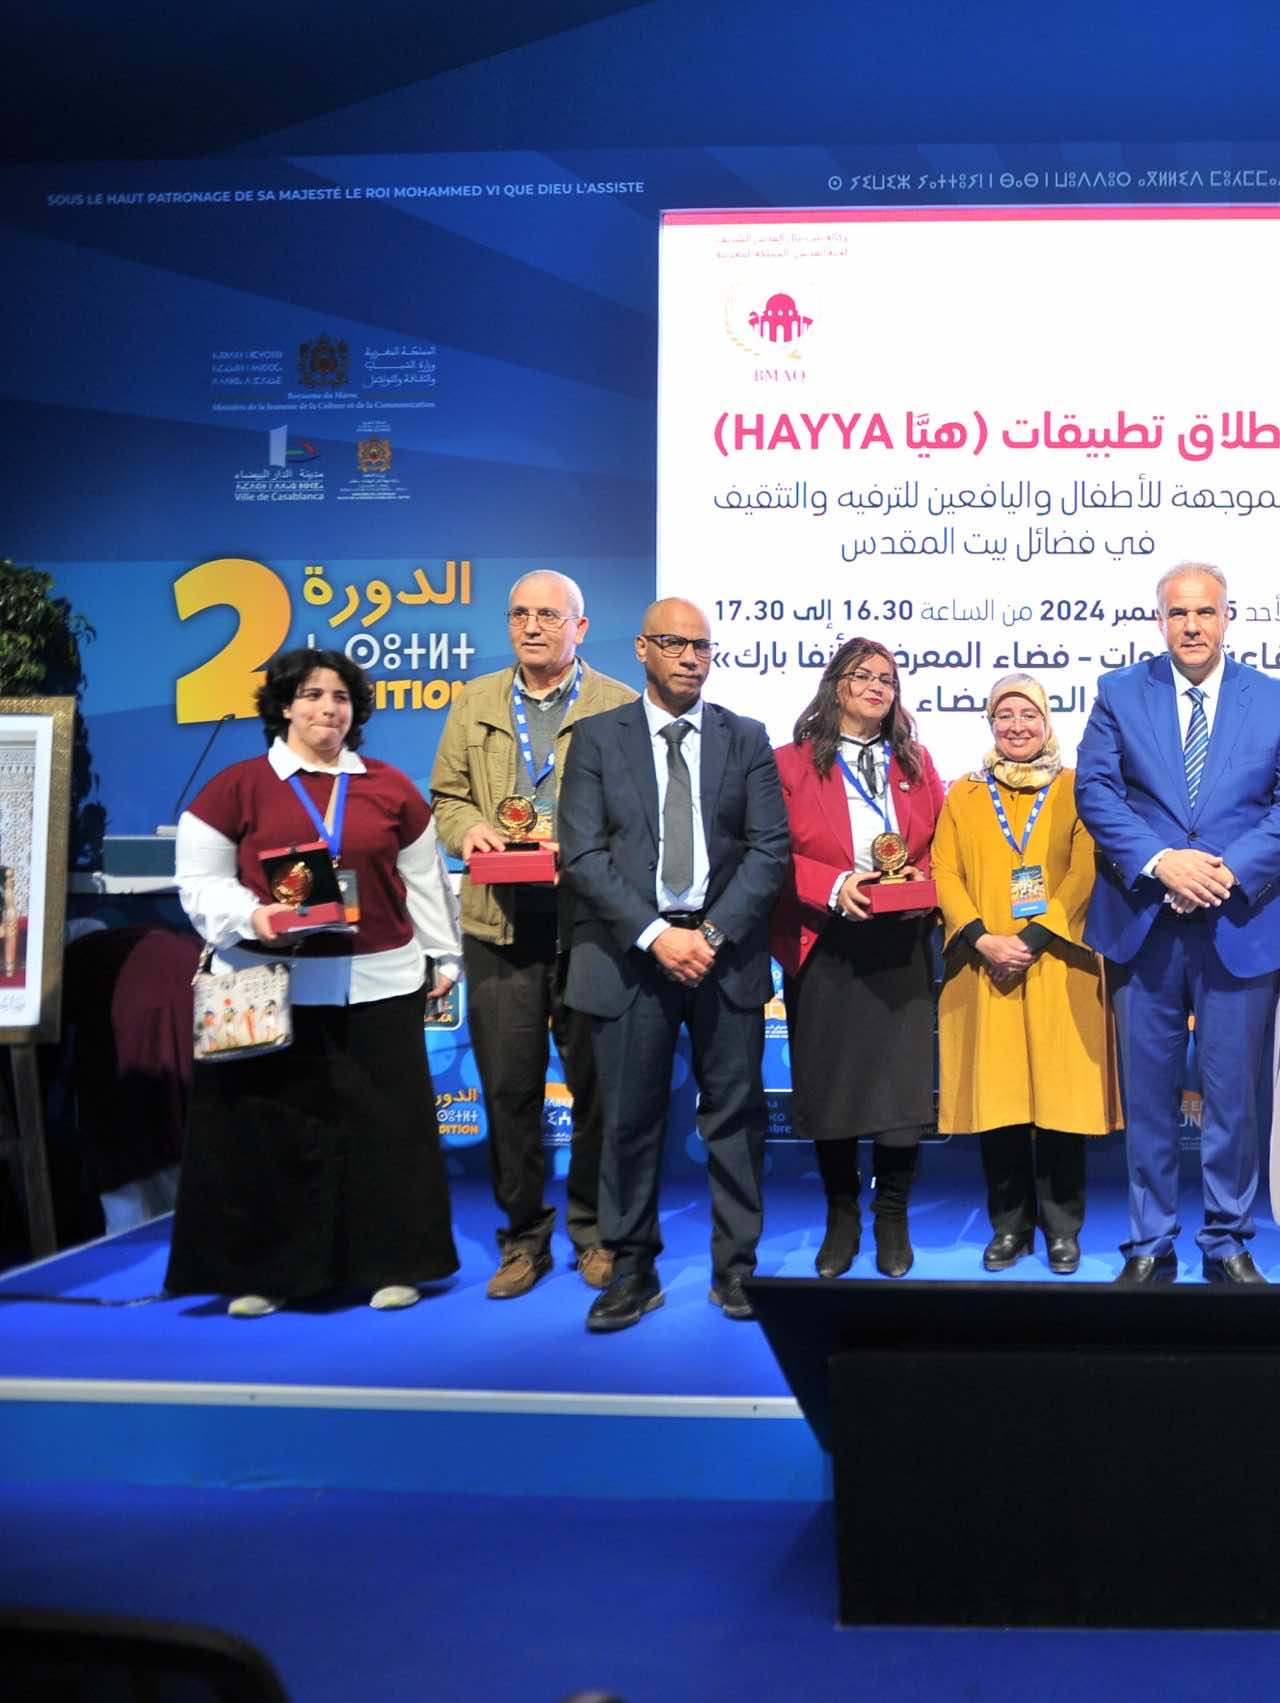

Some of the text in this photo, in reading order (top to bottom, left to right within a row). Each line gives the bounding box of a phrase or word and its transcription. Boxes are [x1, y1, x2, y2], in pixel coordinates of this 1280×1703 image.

[48, 182, 644, 206] SOUS LE HAUT PATRONAGE DE SA MAJESTÉ LE ROI MOHAMMED VI QUE DIEU L'ASSISTE
[1002, 411, 1165, 458] تطبيقات
[714, 481, 828, 516] والتثقيف
[837, 480, 918, 516] للترفيه
[928, 481, 1051, 516] واليافعين
[1061, 473, 1161, 515] للأطفال
[841, 526, 1155, 562] في فضائل بيت المقدس
[303, 560, 471, 628] الدورة
[715, 600, 784, 621] 17.30
[794, 598, 832, 629] إلى
[843, 600, 913, 621] 16.30
[921, 599, 994, 621] الساعة
[1003, 604, 1033, 627] من
[1040, 600, 1104, 621] 2024
[174, 558, 292, 724] 2
[993, 641, 1070, 669] فضاء
[435, 1088, 477, 1108] الدور
[439, 1124, 480, 1135] DITION
